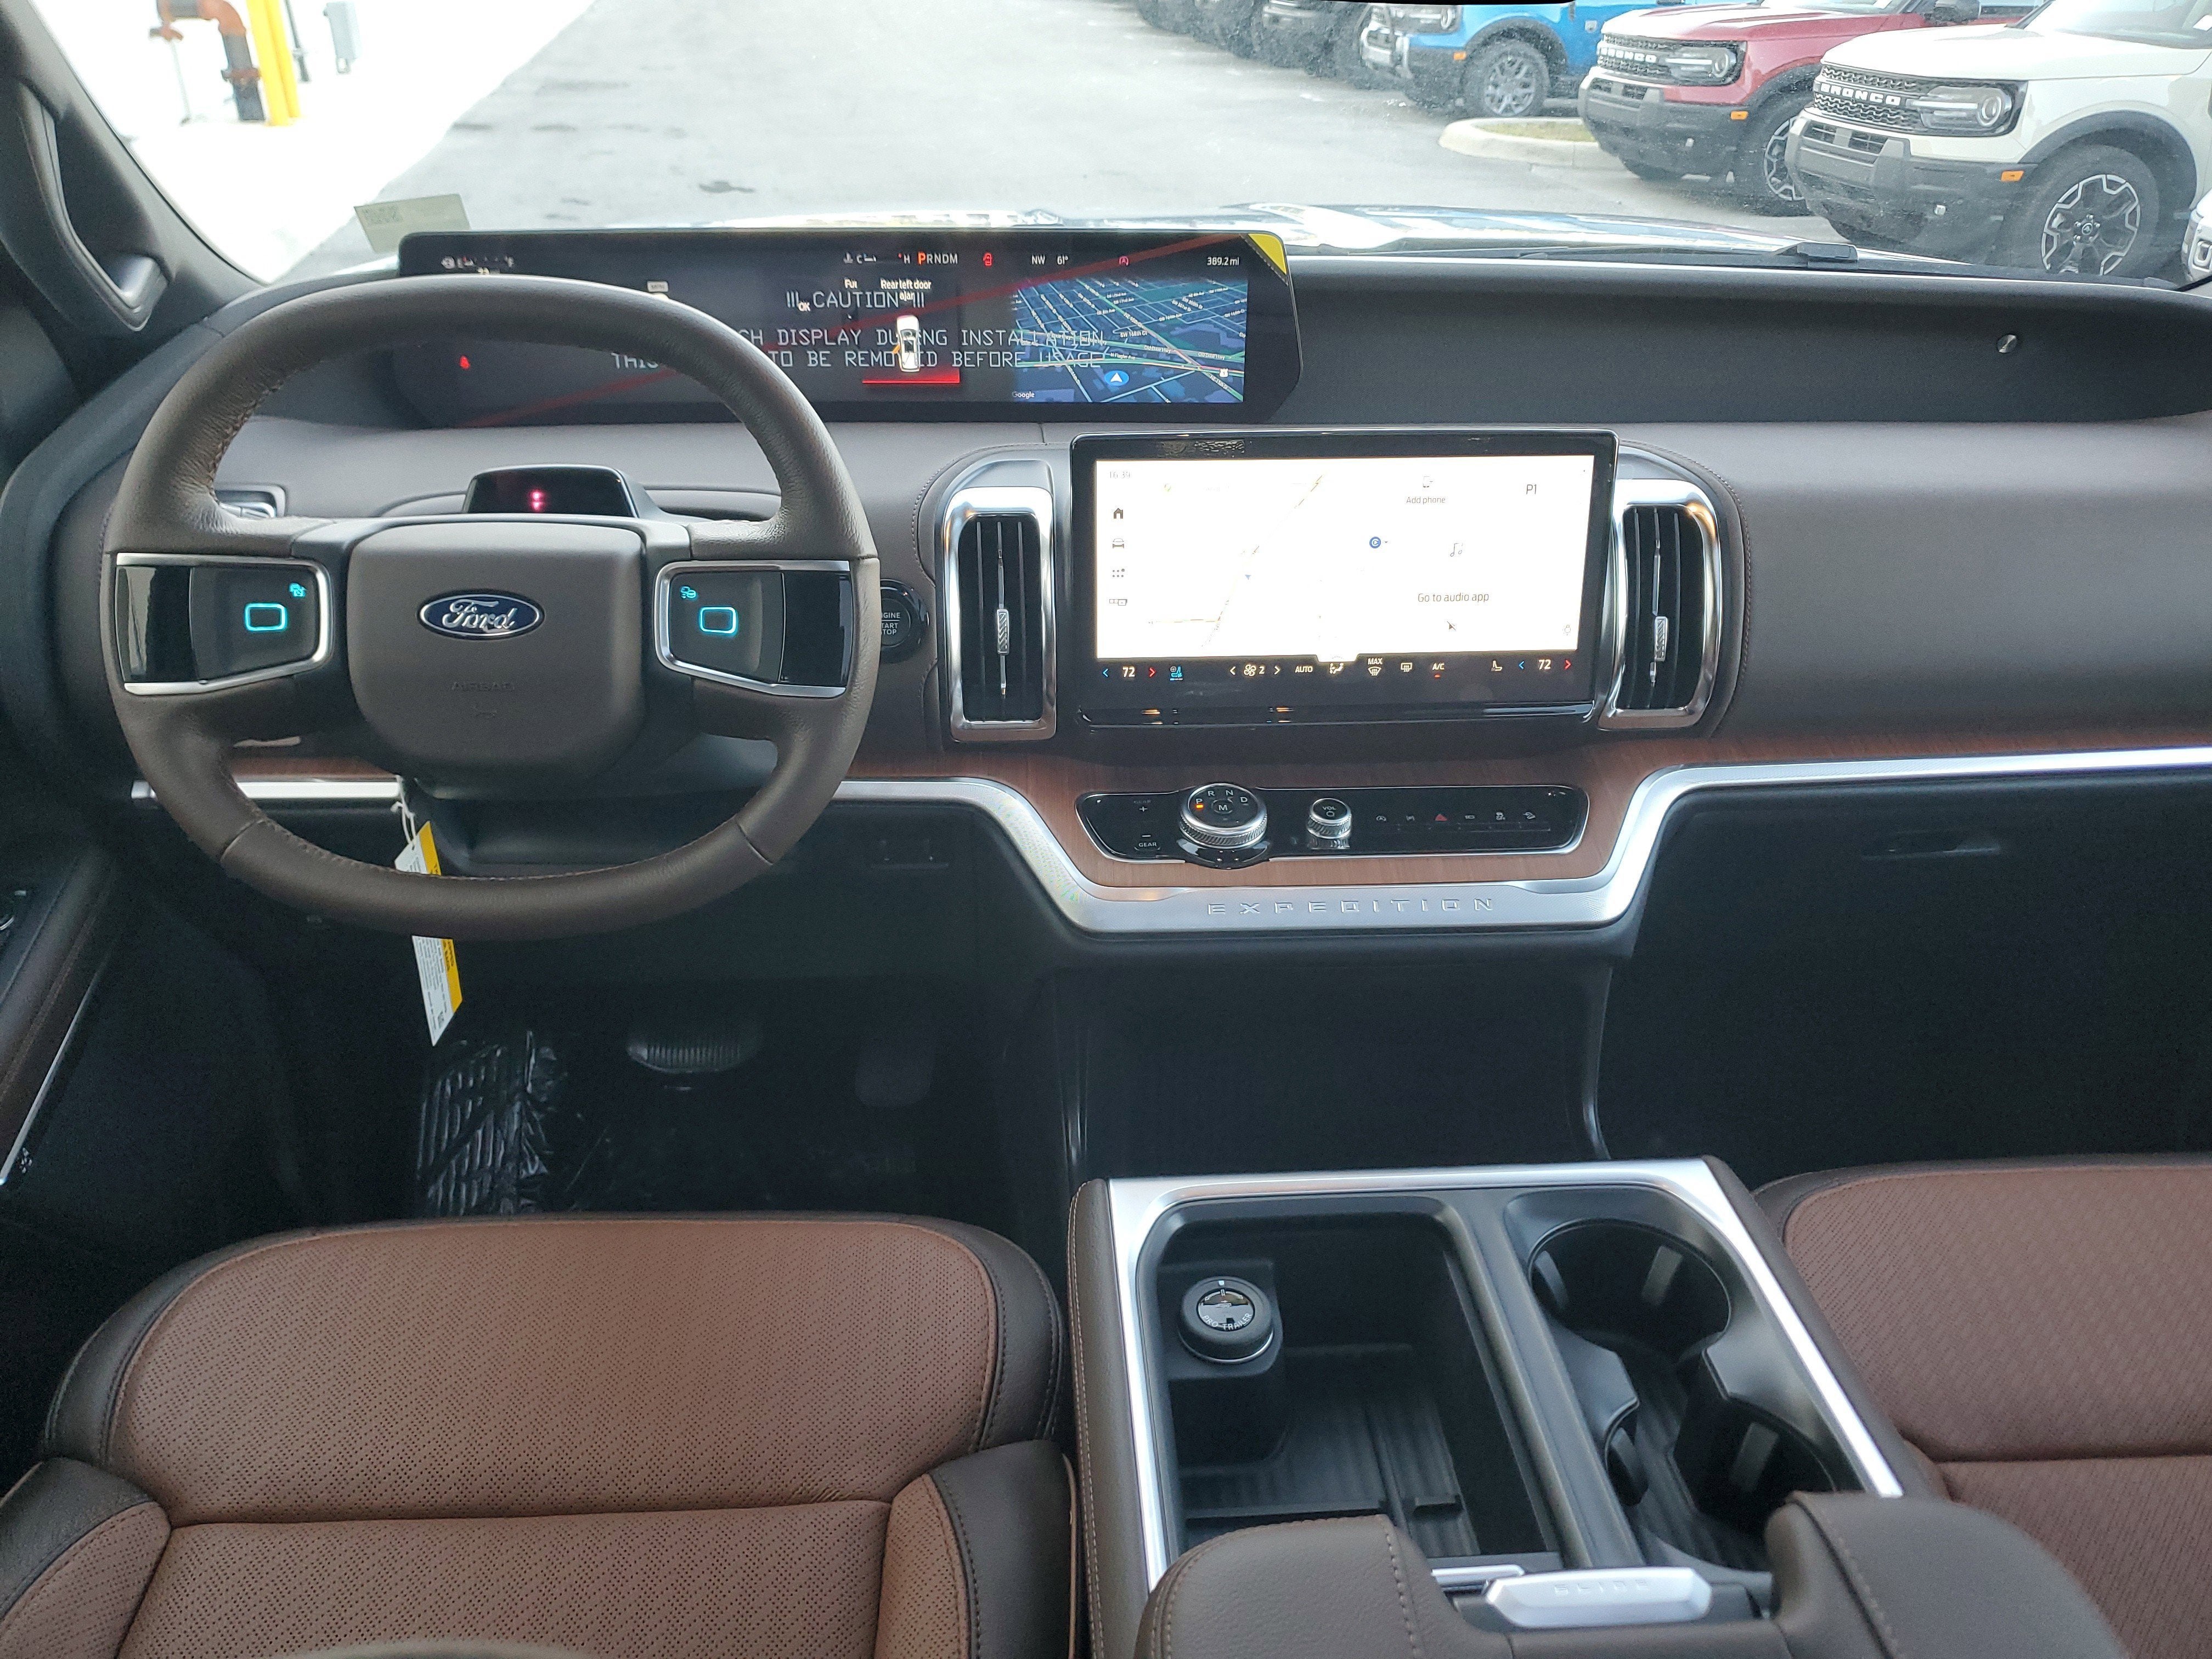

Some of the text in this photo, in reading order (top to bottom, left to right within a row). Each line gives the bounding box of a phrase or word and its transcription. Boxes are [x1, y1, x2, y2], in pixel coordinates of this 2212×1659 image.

[1600, 47, 1657, 63] BRONCO
[1820, 82, 1901, 106] BRONCO
[1031, 255, 1046, 265] NW
[1206, 256, 1228, 266] 389.2
[880, 278, 932, 290] Rear left door
[812, 291, 899, 308] CAUTION
[777, 329, 862, 346] DISPLAY
[806, 351, 831, 367] BE
[845, 351, 938, 367] REMOD
[951, 351, 1026, 368] BEFORE
[1012, 391, 1035, 399] Google
[1526, 484, 1537, 494] P1
[1422, 496, 1446, 505] phone
[1417, 592, 1489, 603] Go to audio app
[442, 599, 517, 628] Ford
[1367, 657, 1383, 665] MAX
[1432, 662, 1445, 670] A/C
[1538, 659, 1551, 670] 72
[1122, 666, 1136, 678] 72
[1259, 665, 1265, 675] 2
[1294, 665, 1313, 674] AUTO
[1207, 898, 1493, 915] EXPEDITION
[1202, 1313, 1253, 1331] PRO TRAILER
